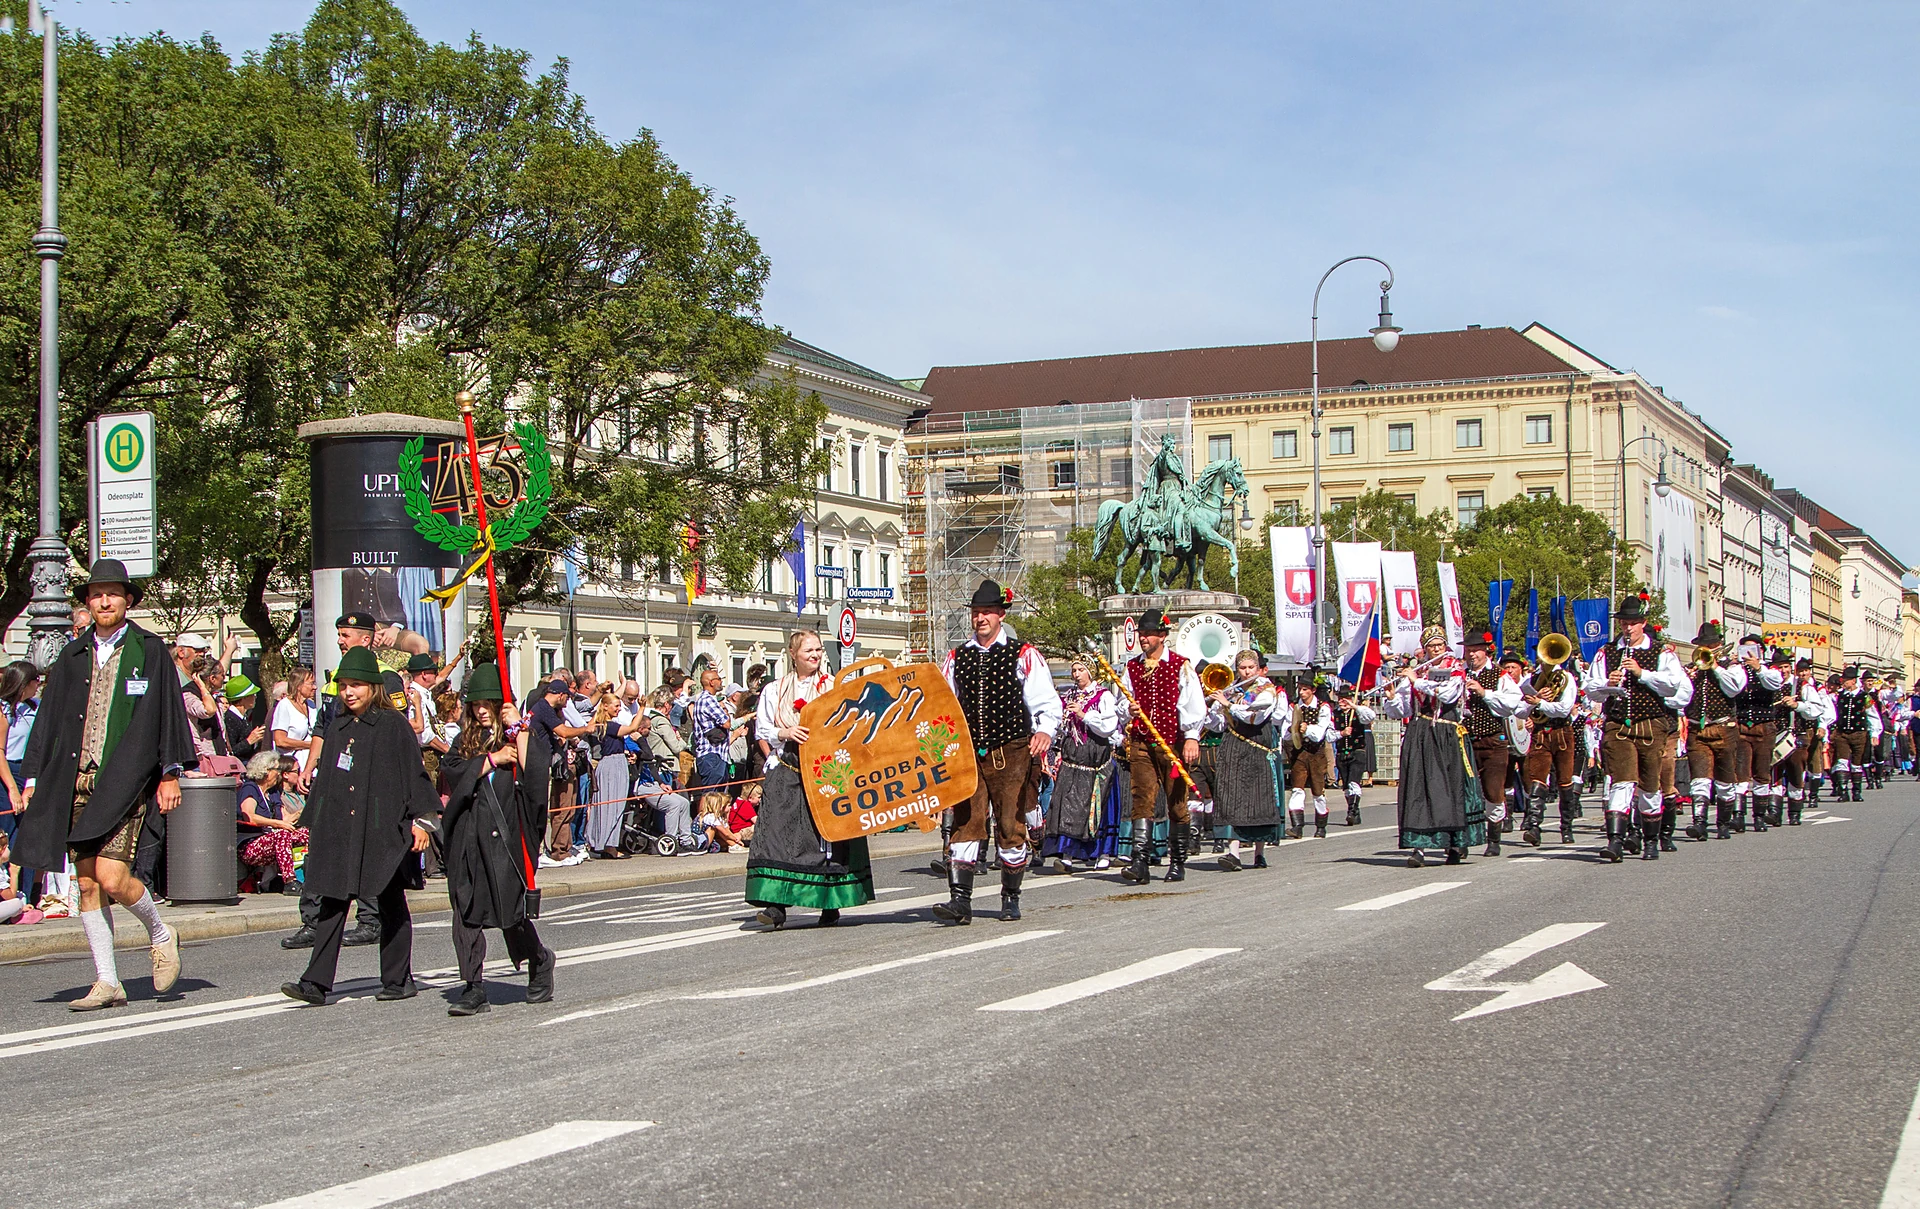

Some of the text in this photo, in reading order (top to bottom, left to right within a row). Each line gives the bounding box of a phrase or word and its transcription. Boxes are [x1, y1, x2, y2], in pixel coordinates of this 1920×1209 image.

[116, 433, 133, 462] H
[363, 474, 430, 491] UPTN
[107, 492, 144, 501] Odeonsplatz
[352, 551, 399, 565] BUILT
[817, 566, 844, 577] Odeonsplatz
[848, 588, 891, 598] Odeonsplatz
[1285, 611, 1313, 619] SPATE
[1215, 618, 1237, 646] GORJE
[1766, 628, 1827, 644] Slovenija
[896, 670, 916, 684] 1907
[854, 755, 928, 788] GODBA
[831, 761, 952, 817] GORJE
[859, 793, 940, 830] Slovenija
